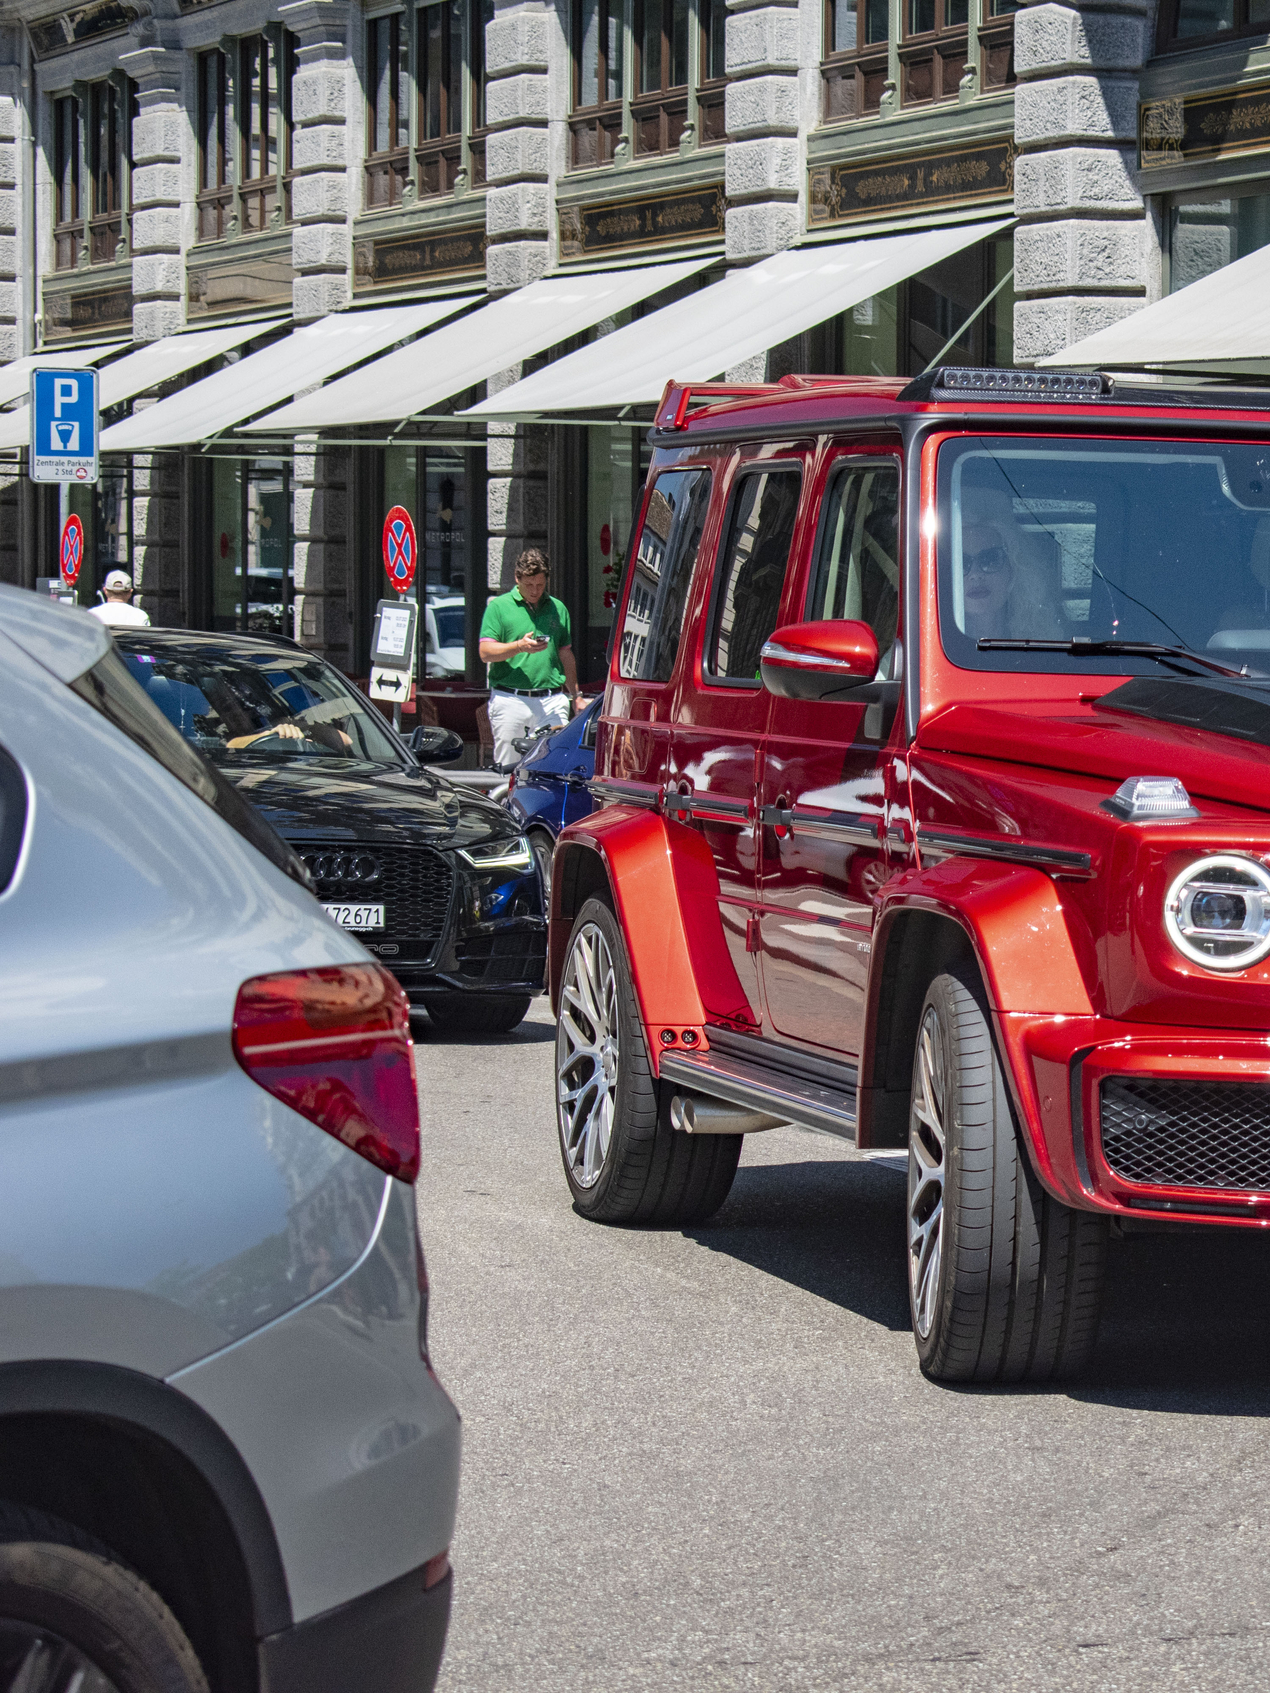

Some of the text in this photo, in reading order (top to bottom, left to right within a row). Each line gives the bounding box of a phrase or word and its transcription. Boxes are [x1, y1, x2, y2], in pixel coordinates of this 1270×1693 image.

[54, 378, 79, 418] P
[36, 459, 94, 467] Zentrale Parkuhr
[61, 468, 75, 476] Std.
[326, 907, 381, 925] 72671
